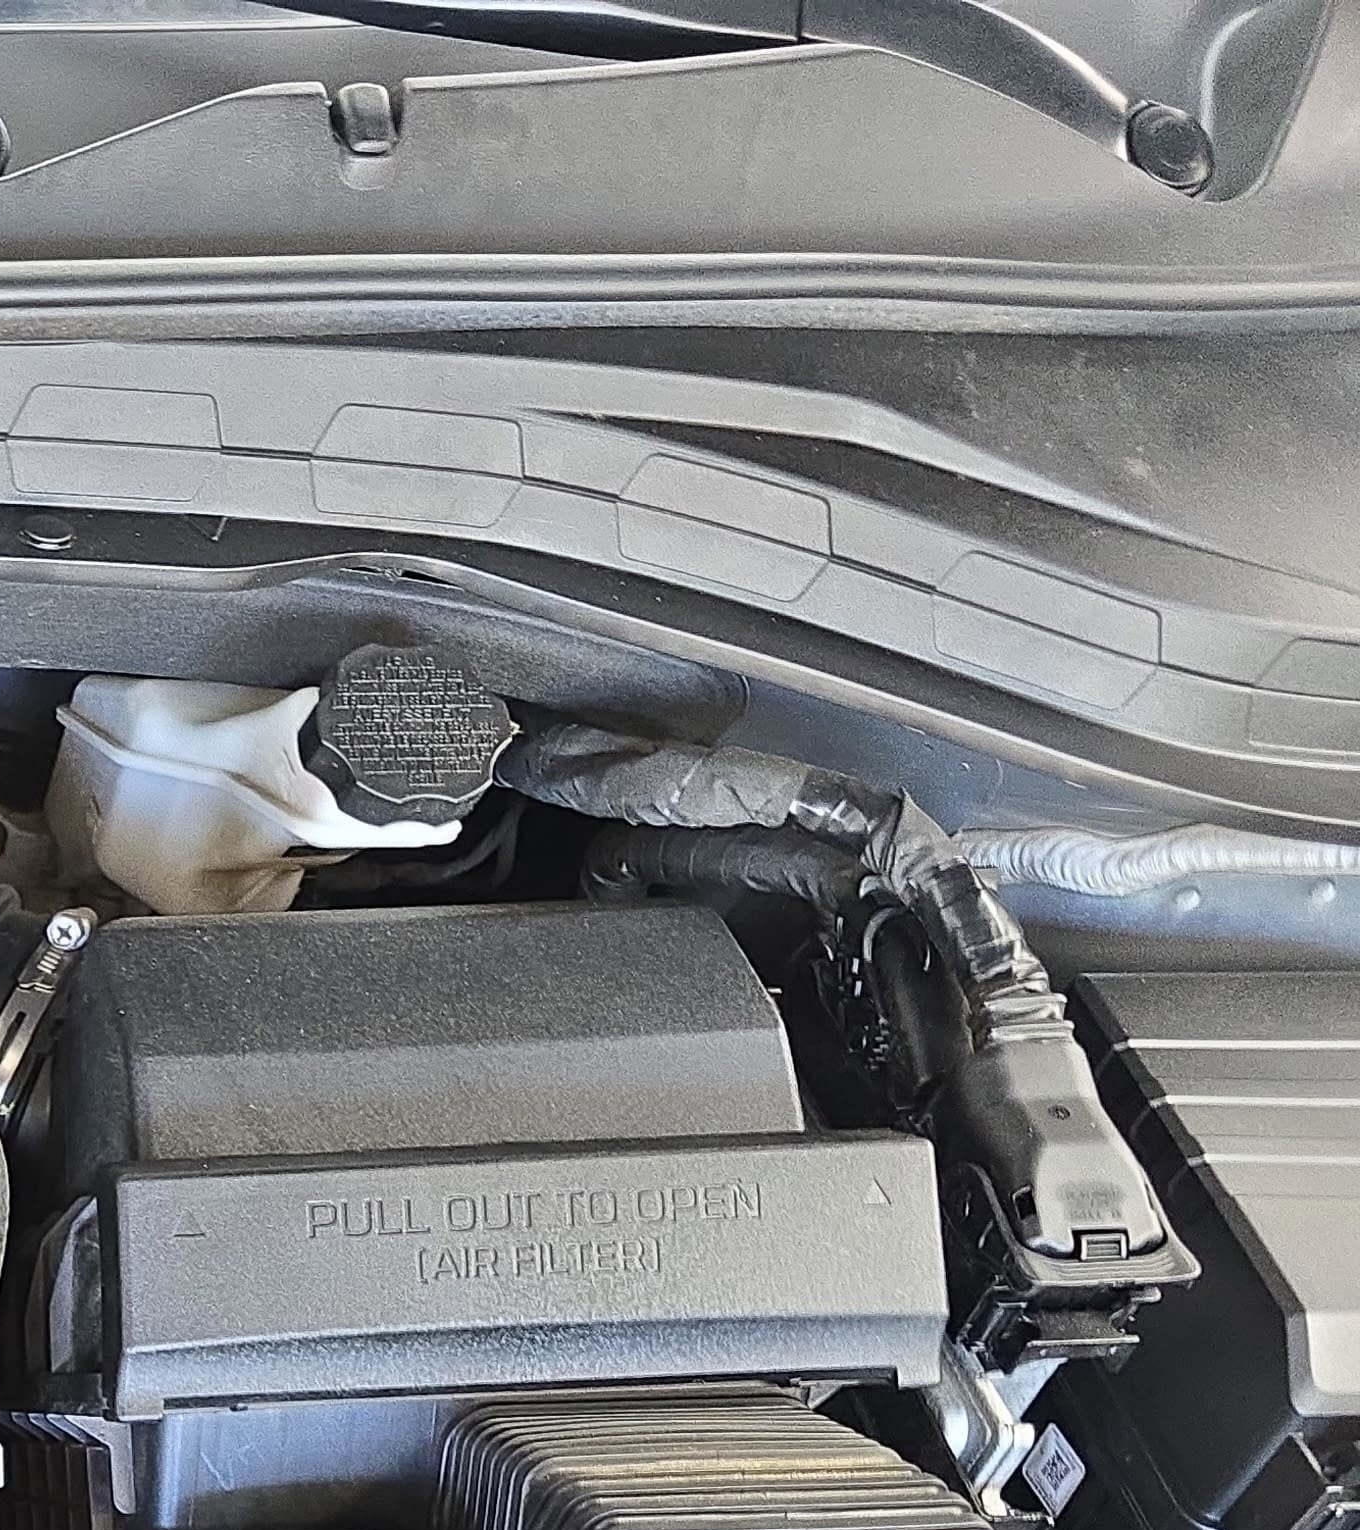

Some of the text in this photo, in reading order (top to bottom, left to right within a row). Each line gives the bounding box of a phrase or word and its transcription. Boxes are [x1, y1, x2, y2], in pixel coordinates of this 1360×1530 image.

[306, 1181, 762, 1238] PULL OUT TO OPEN
